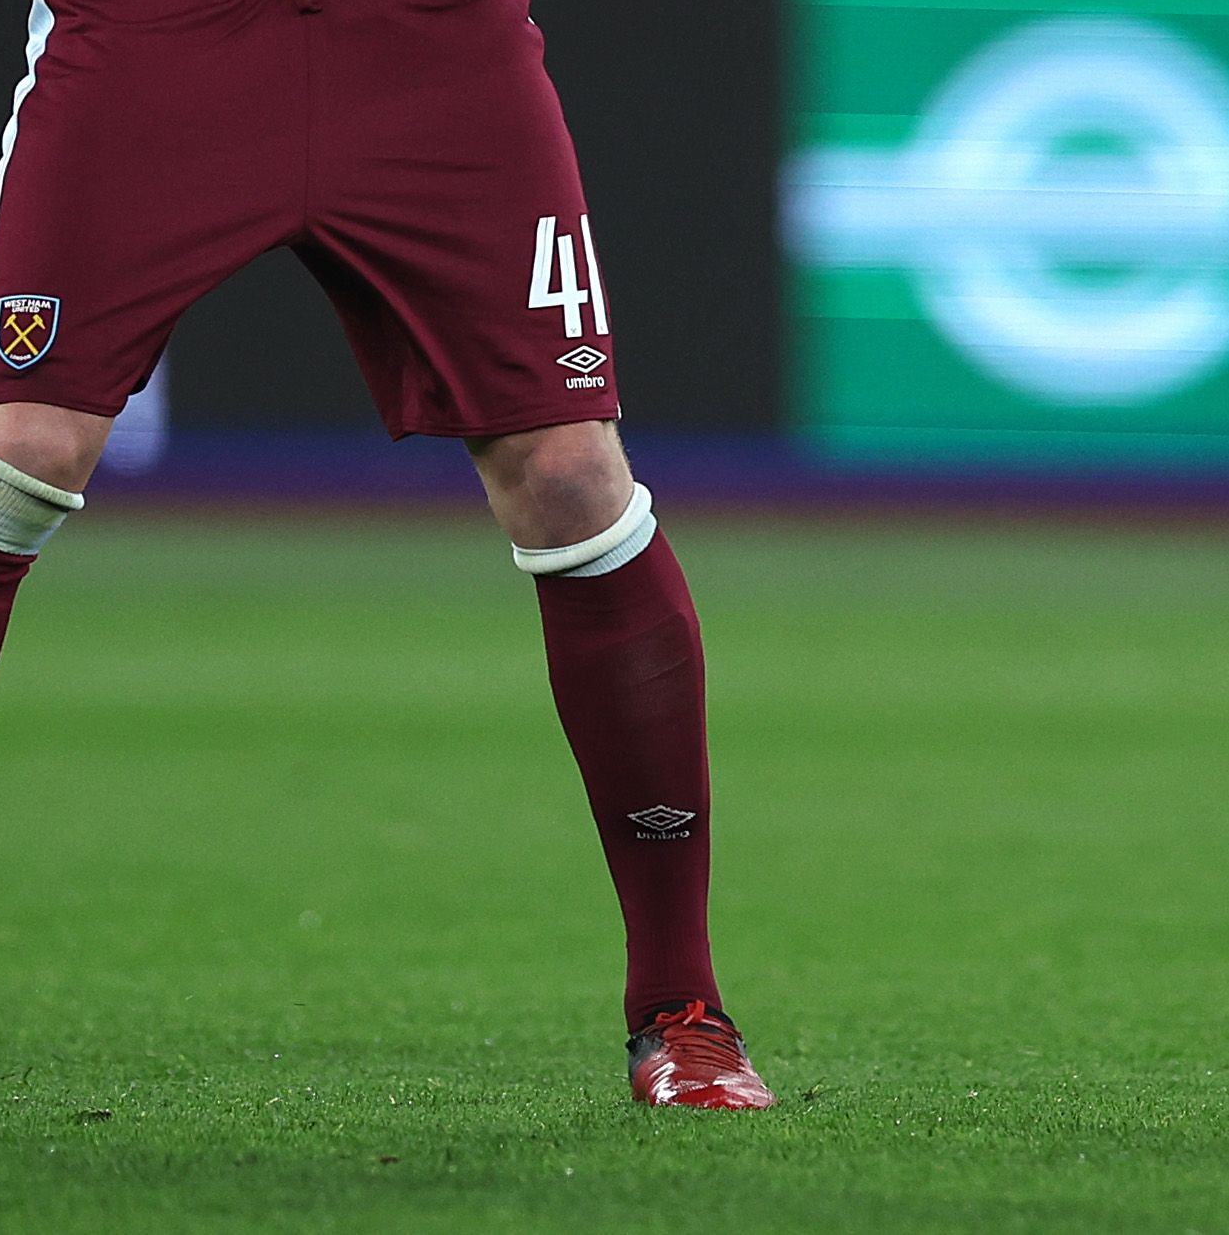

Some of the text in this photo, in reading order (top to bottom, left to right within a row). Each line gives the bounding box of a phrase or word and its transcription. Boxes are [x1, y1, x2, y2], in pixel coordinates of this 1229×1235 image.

[528, 214, 610, 338] 41
[4, 299, 51, 310] WEST HAM
[565, 374, 605, 390] umbro
[635, 829, 690, 840] umbro
